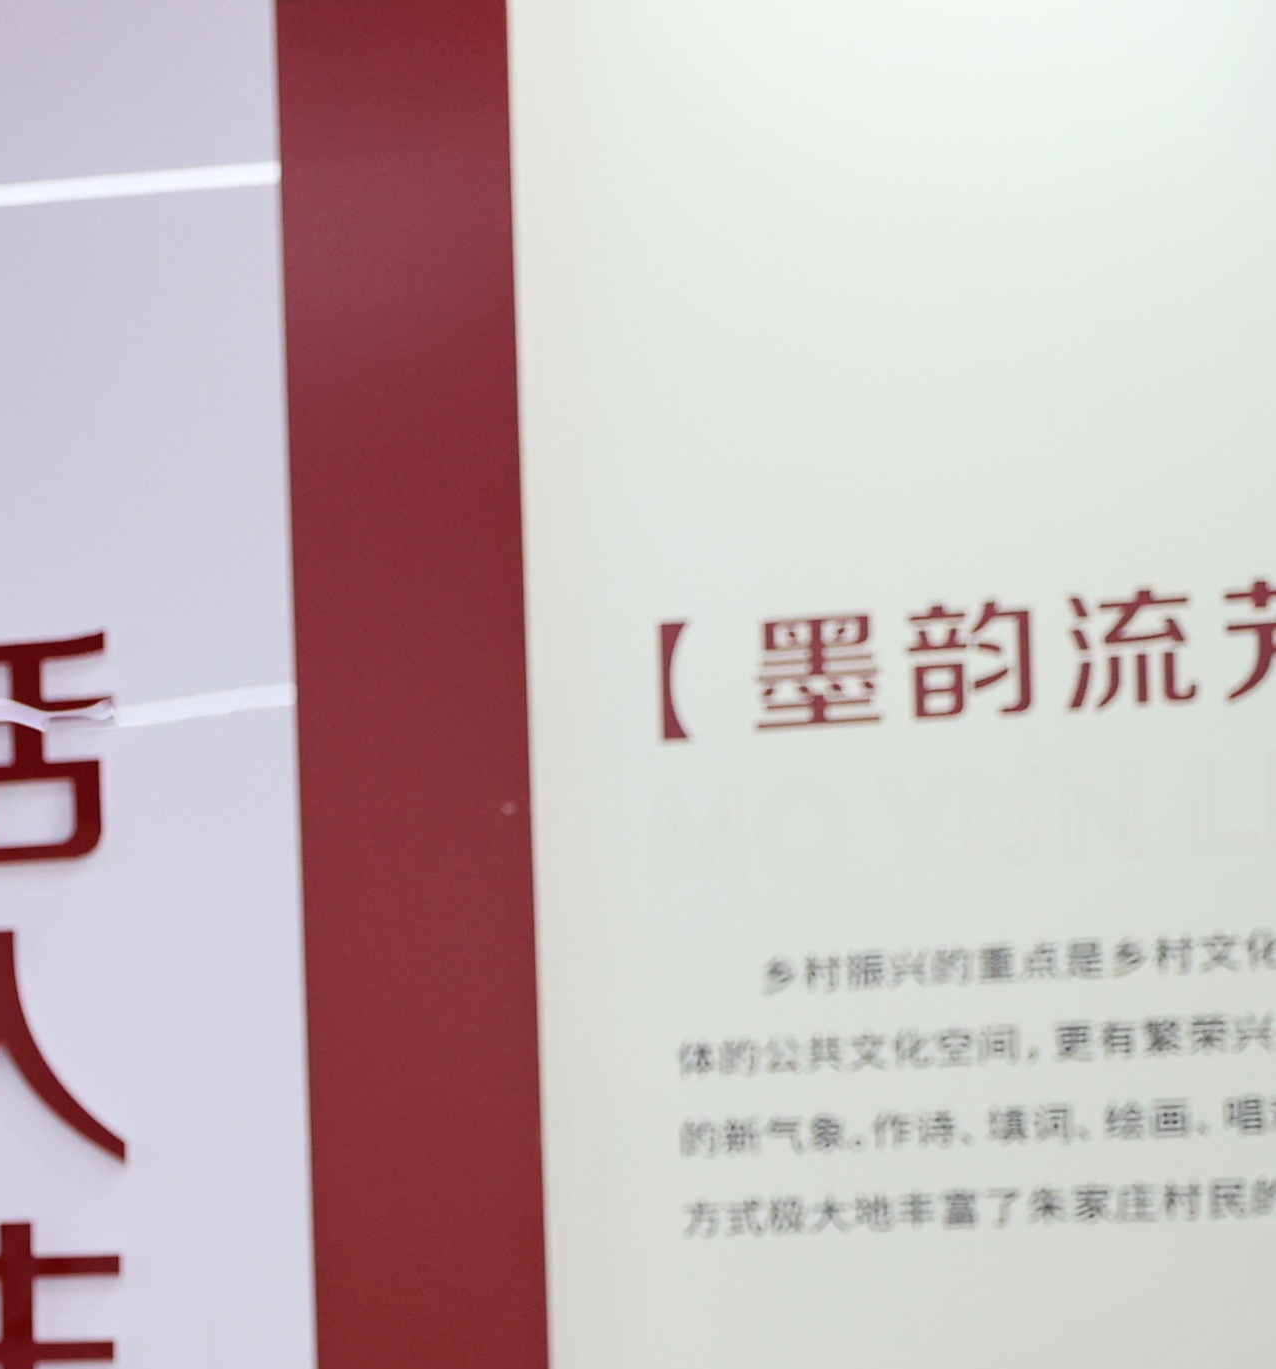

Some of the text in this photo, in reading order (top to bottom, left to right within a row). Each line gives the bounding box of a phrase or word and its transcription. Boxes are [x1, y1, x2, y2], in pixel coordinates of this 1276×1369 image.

[680, 1094, 1276, 1158] 的新气象。作诗、填词、绘画、唱
